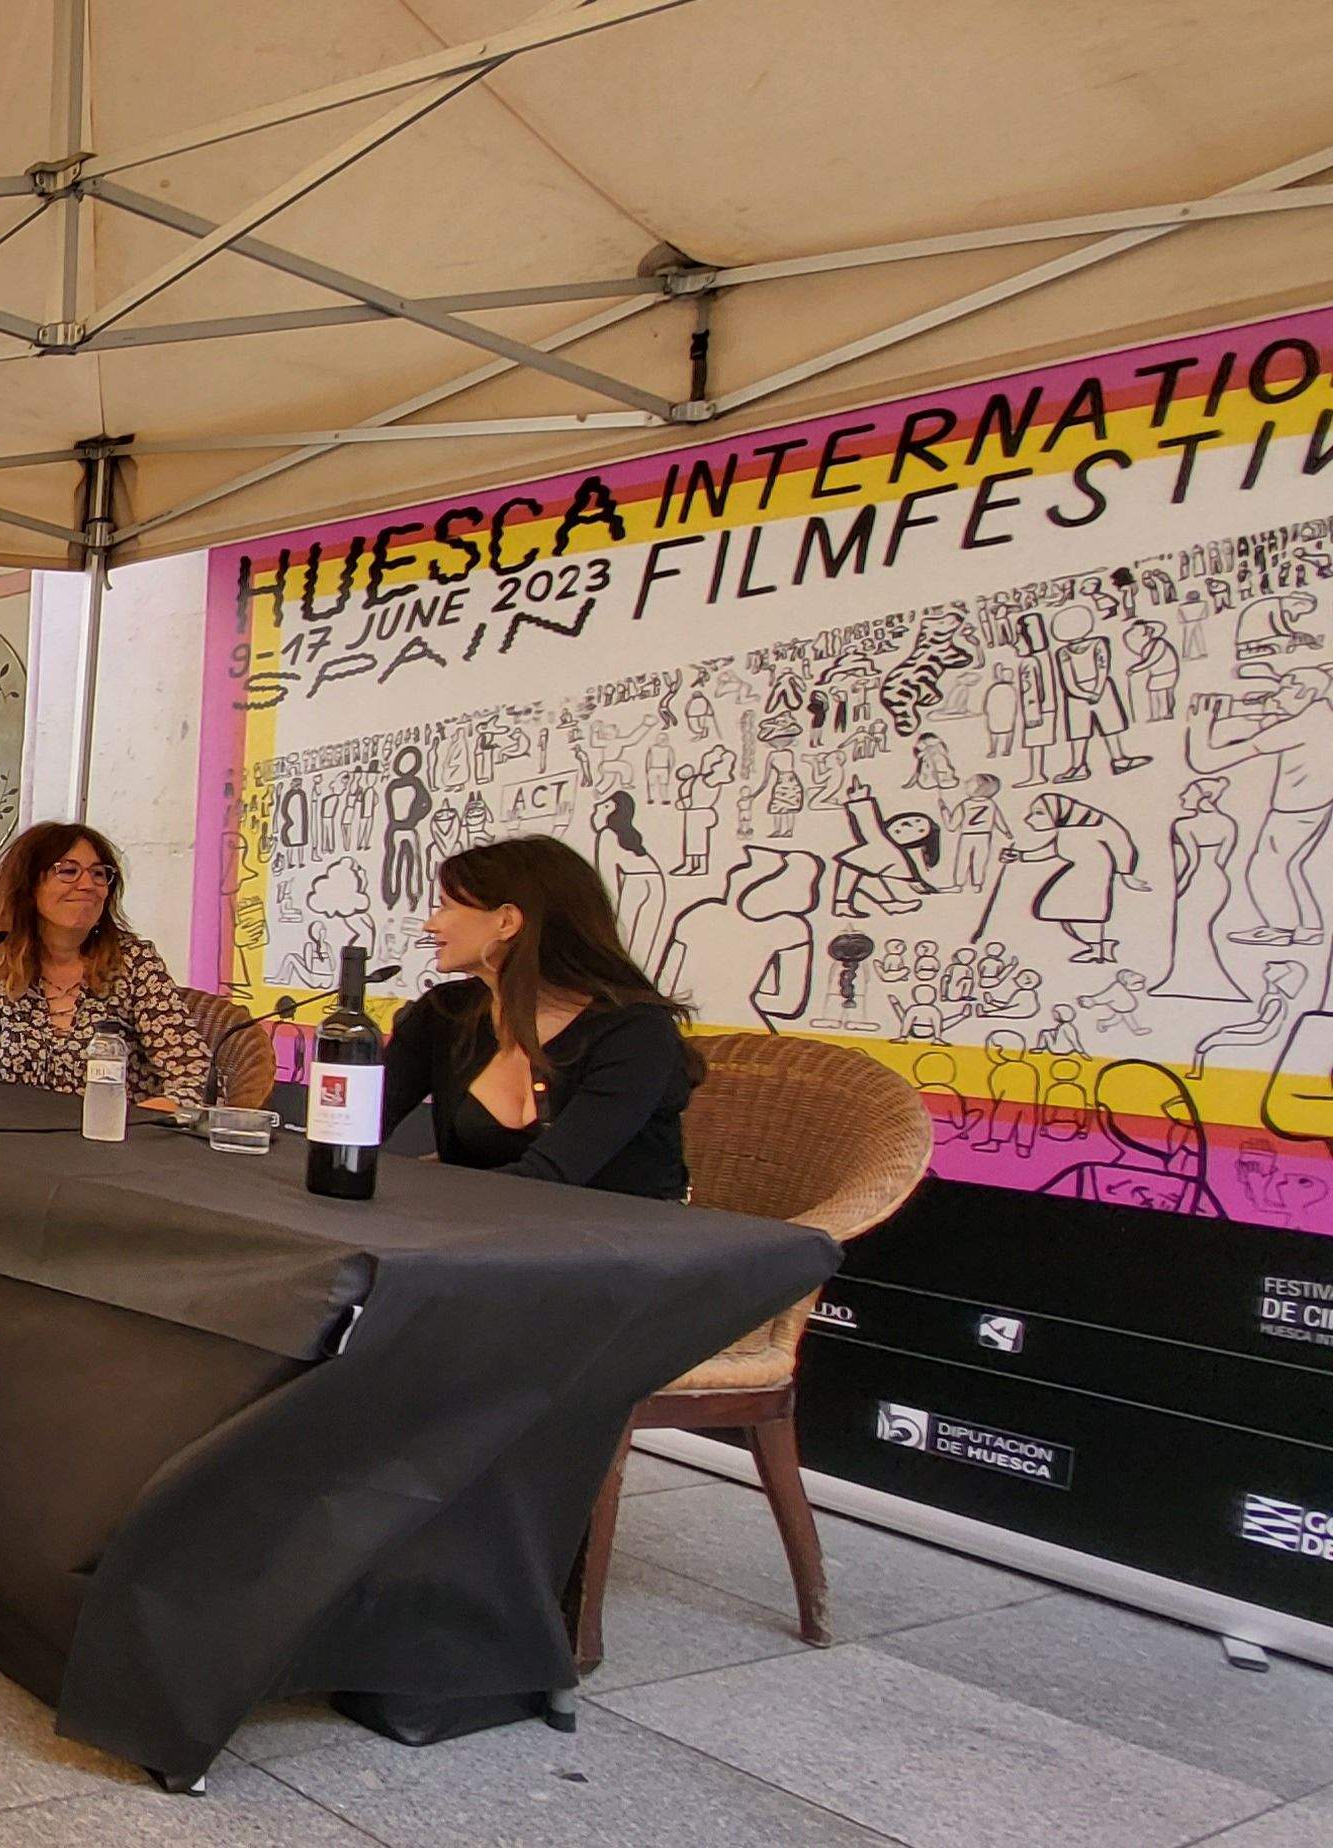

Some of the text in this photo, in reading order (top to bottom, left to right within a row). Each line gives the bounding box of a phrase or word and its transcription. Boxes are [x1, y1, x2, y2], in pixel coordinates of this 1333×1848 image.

[237, 338, 1333, 634] HUESCA INTERNATIO
[228, 558, 612, 678] 9-17 JUNE 2023
[233, 597, 597, 710] SPAIN
[512, 780, 569, 814] ACT
[1264, 1276, 1333, 1300] FESTIV
[1261, 1297, 1333, 1330] DE CI
[936, 1438, 1051, 1479] DE HUESCA
